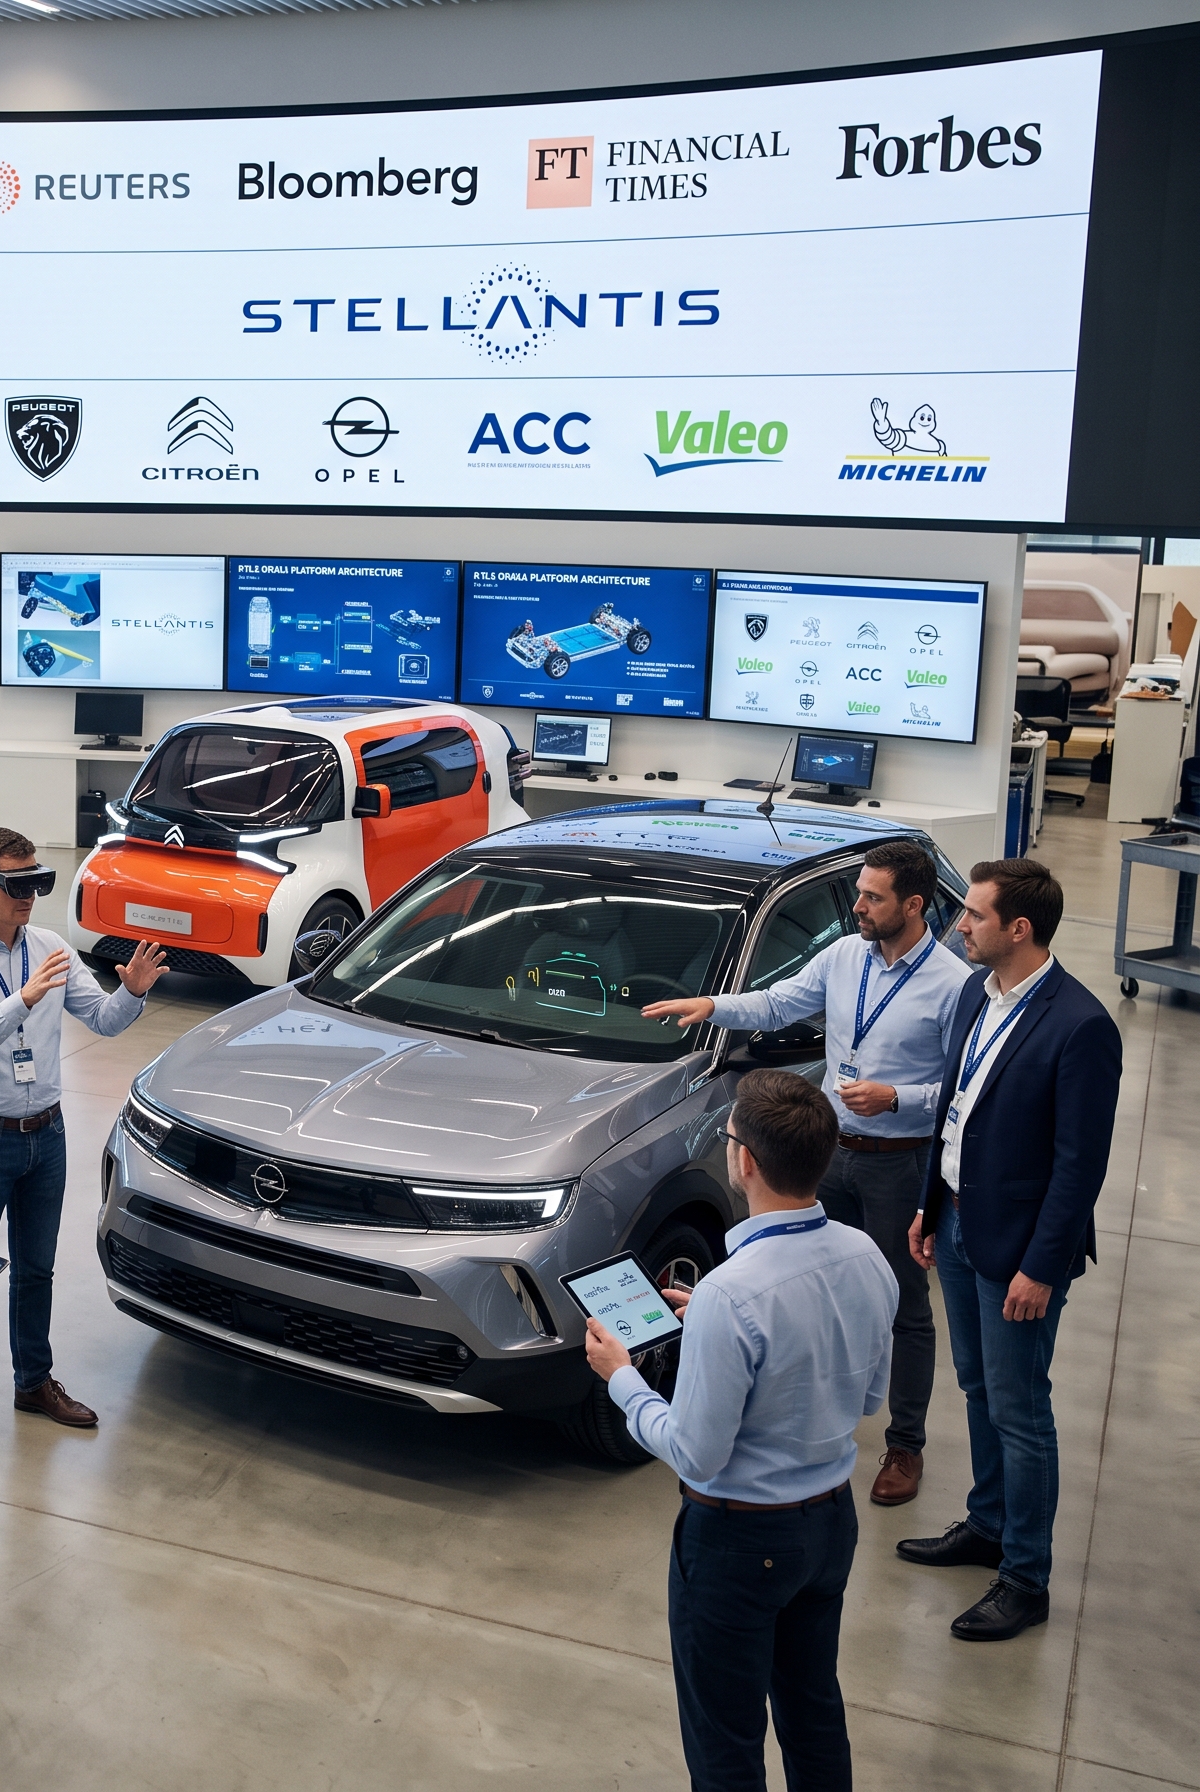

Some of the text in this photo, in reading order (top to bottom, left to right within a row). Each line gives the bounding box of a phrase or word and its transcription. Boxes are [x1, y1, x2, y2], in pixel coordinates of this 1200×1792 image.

[606, 130, 790, 167] FINANCIAL
[835, 114, 1042, 180] Forbes
[534, 146, 588, 181] FT
[35, 172, 191, 201] REUTERS
[238, 156, 478, 206] Bloomberg
[605, 172, 708, 203] TIMES
[242, 289, 720, 334] STELLANTIS
[12, 403, 76, 413] PEUGEOT
[467, 411, 592, 456] ACC
[655, 410, 789, 455] Valeo
[314, 468, 405, 484] OPEL
[837, 464, 988, 483] MICHELIN
[290, 566, 336, 576] PLATFORM
[338, 568, 404, 577] ARCHITECTURE
[530, 573, 579, 583] PLATFORM
[580, 575, 651, 586] ARCHITECTURE
[111, 619, 214, 629] STELLANTIS
[909, 647, 944, 656] OPEL
[845, 666, 882, 682] ACC
[906, 669, 948, 685] Valeo
